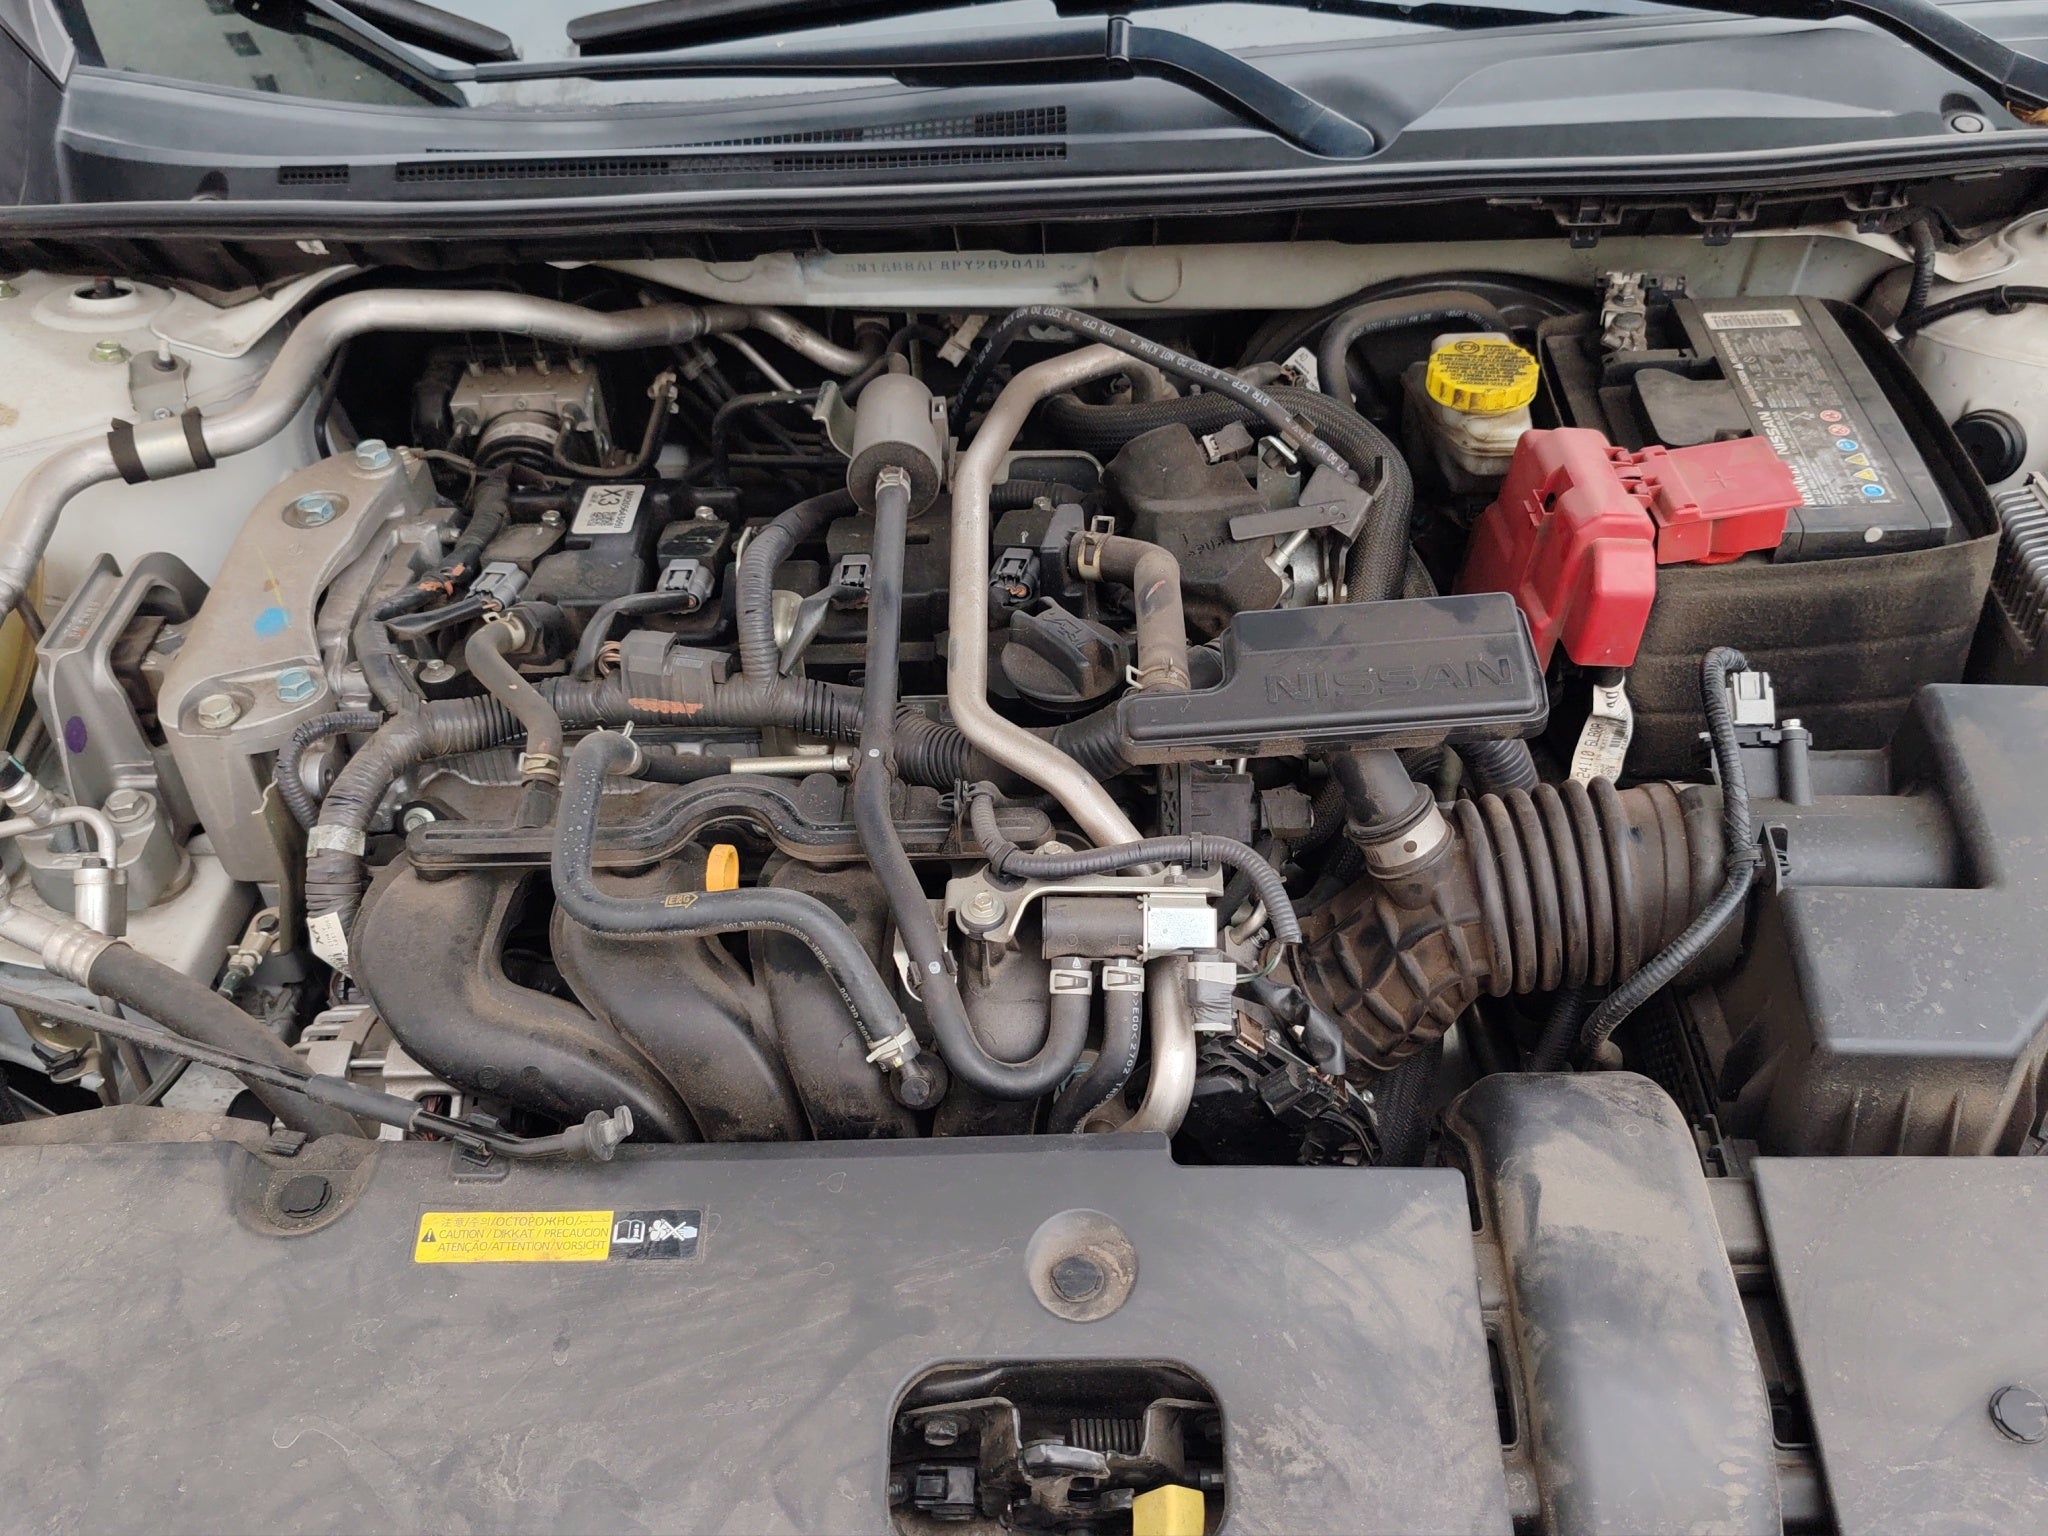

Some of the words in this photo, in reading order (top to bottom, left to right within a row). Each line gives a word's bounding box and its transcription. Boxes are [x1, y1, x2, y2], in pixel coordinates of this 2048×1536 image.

[1137, 341, 1159, 356] KINK
[1160, 352, 1176, 363] NOT
[1756, 411, 1790, 455] NISSAN
[598, 488, 625, 506] X3
[1264, 655, 1514, 704] NISSAN
[1577, 750, 1595, 779] 24110
[439, 1229, 485, 1239] CAUTION
